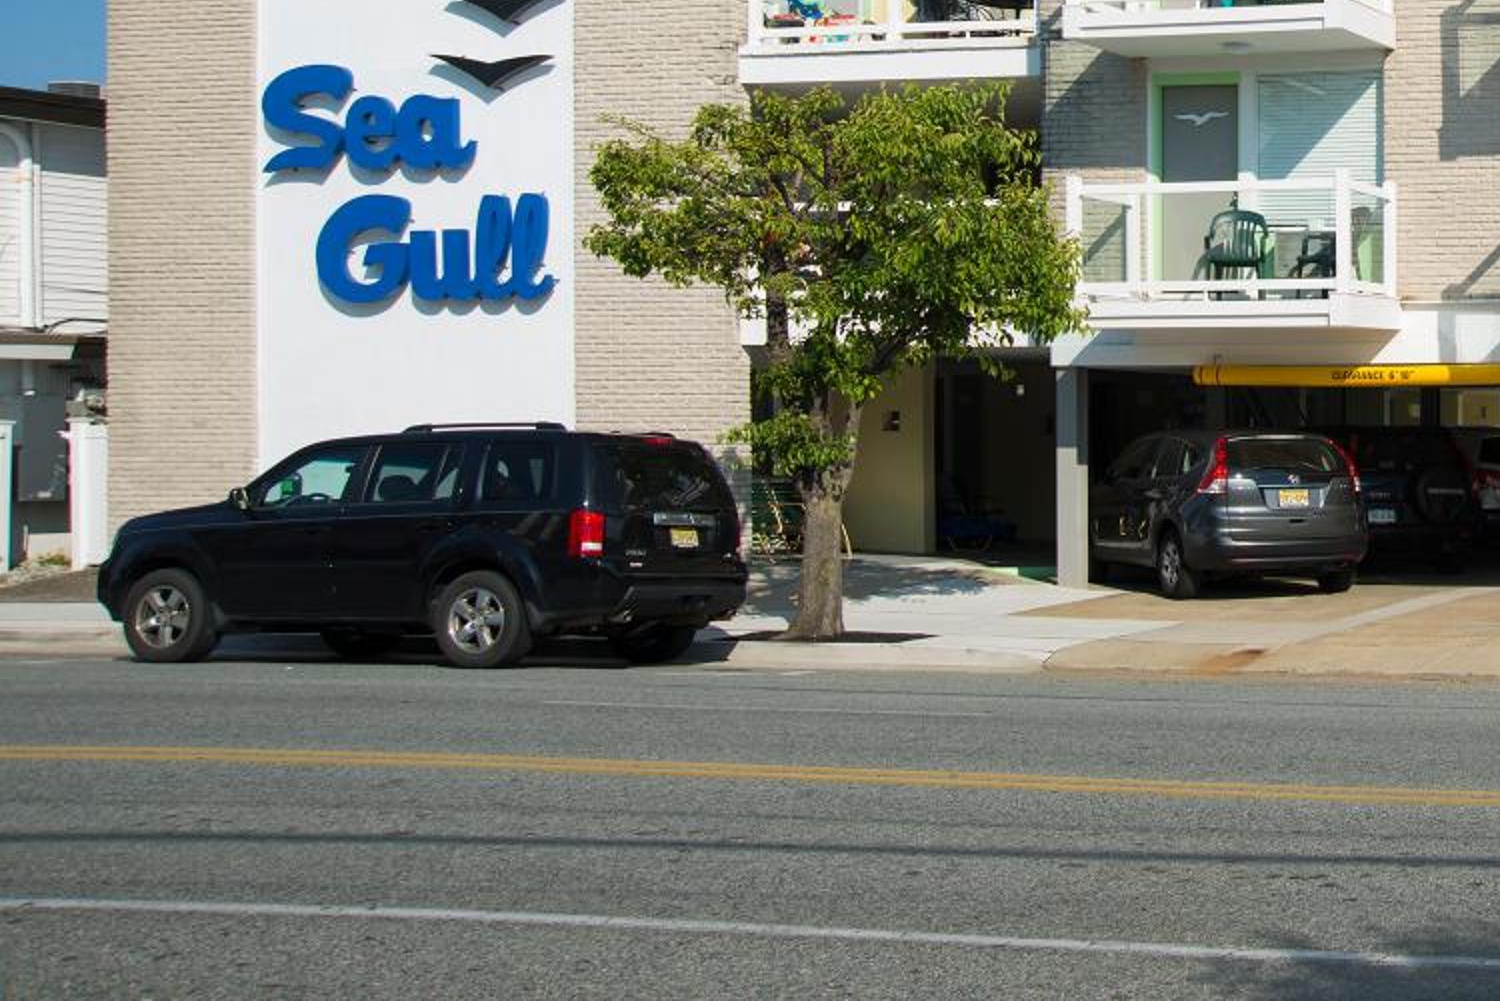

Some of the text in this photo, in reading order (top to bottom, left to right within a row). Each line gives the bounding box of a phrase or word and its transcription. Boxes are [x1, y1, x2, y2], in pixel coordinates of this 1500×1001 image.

[261, 64, 478, 175] Sea
[315, 193, 556, 304] Gull
[1331, 369, 1384, 381] CLEARANCE
